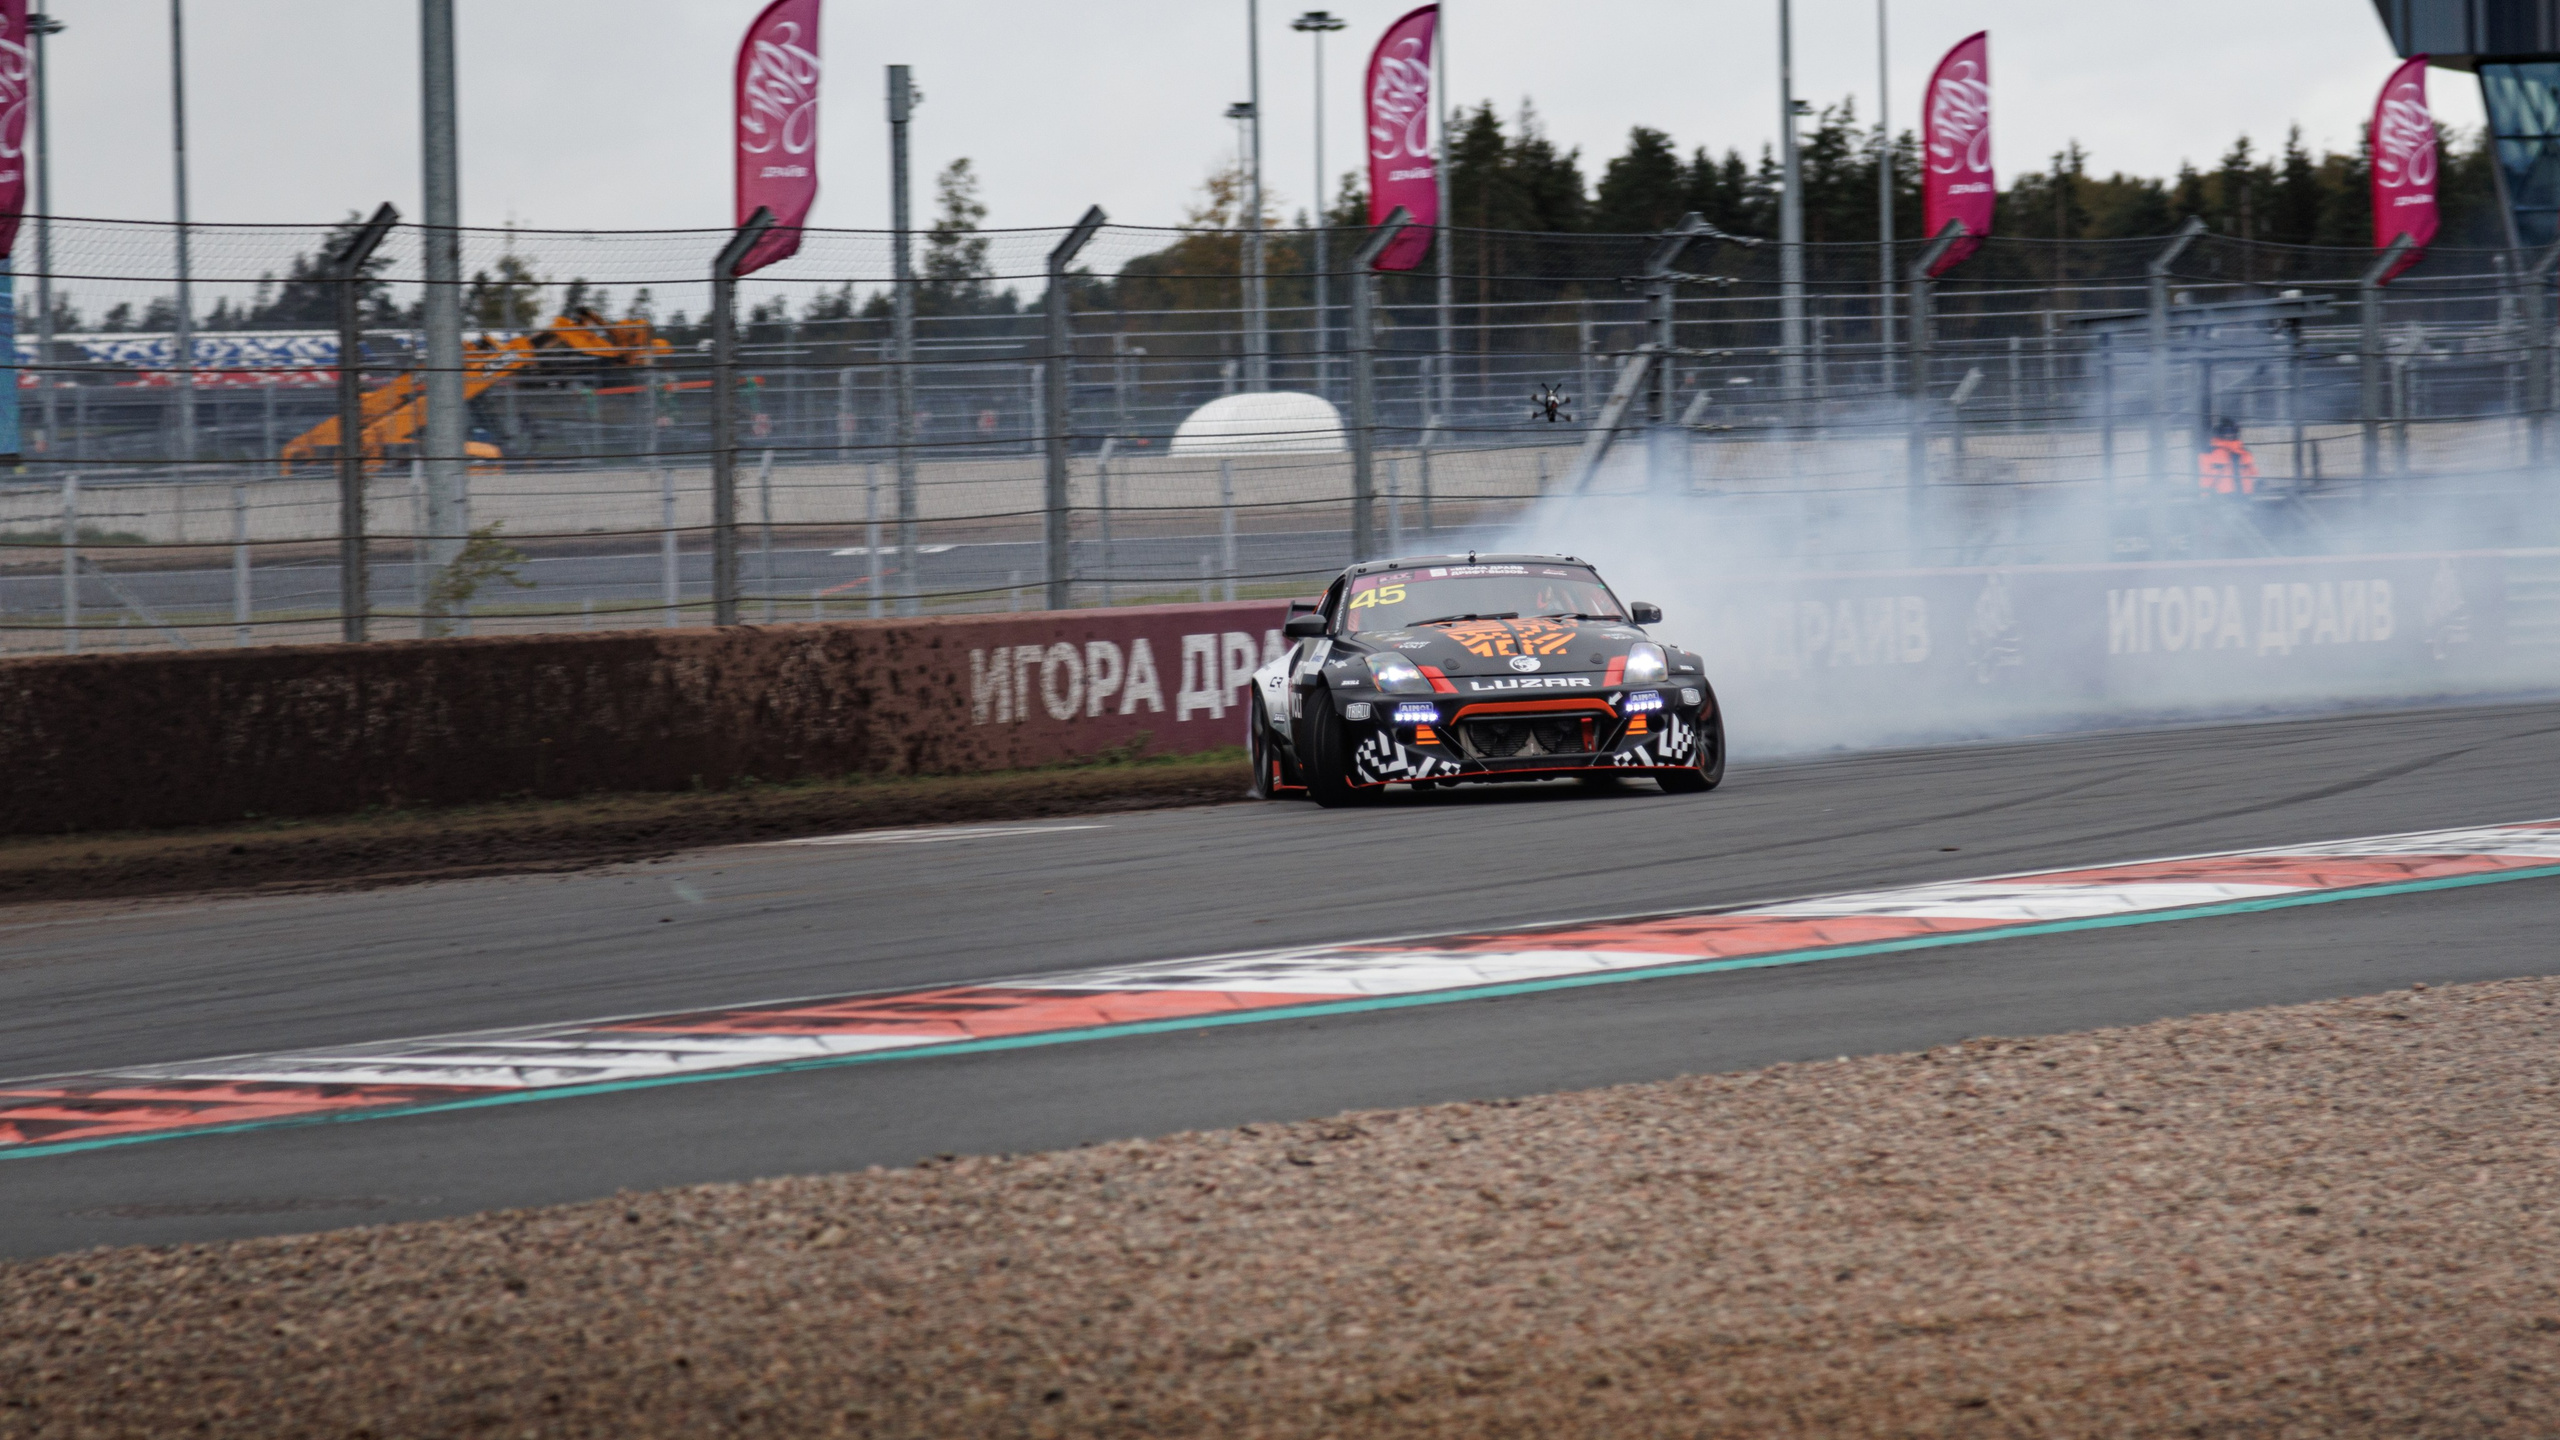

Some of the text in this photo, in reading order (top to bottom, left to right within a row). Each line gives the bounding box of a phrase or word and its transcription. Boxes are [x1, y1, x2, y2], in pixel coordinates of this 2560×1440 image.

[1350, 583, 1407, 609] 45
[2105, 584, 2247, 655] ИГОРА
[968, 638, 1166, 726] ИГОРА
[1470, 677, 1592, 691] LUZAR
